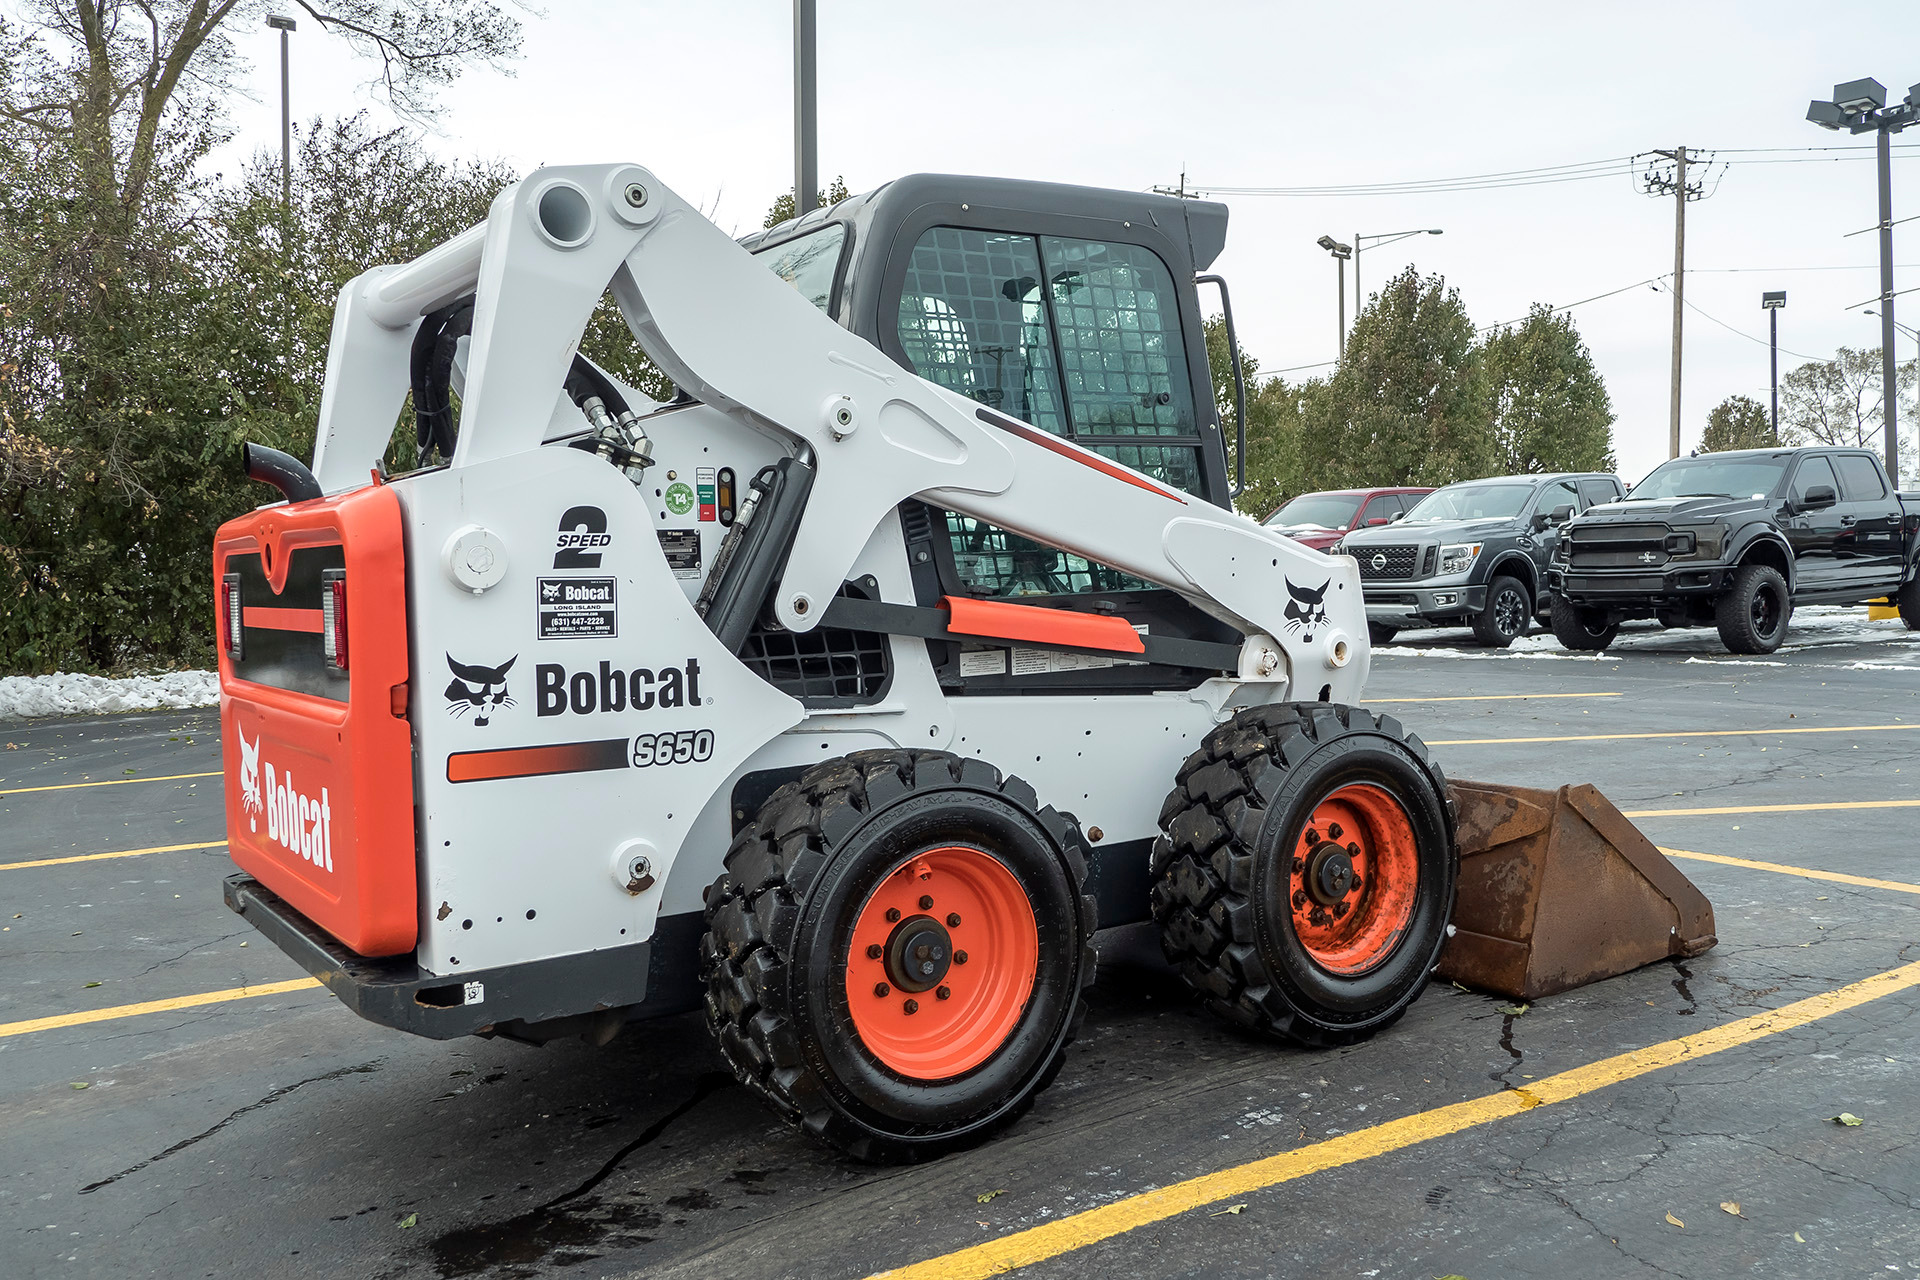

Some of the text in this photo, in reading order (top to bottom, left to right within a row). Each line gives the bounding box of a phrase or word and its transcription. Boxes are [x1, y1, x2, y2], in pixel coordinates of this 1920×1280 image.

[673, 493, 687, 505] T4
[668, 502, 692, 513] COMPLIANT
[553, 506, 608, 570] 2
[556, 534, 612, 548] SPEED
[565, 585, 610, 600] Bobcat
[552, 616, 604, 626] (631) 447-2228
[535, 657, 702, 717] Bobcat
[632, 729, 715, 768] S650
[264, 761, 333, 874] Bobcat
